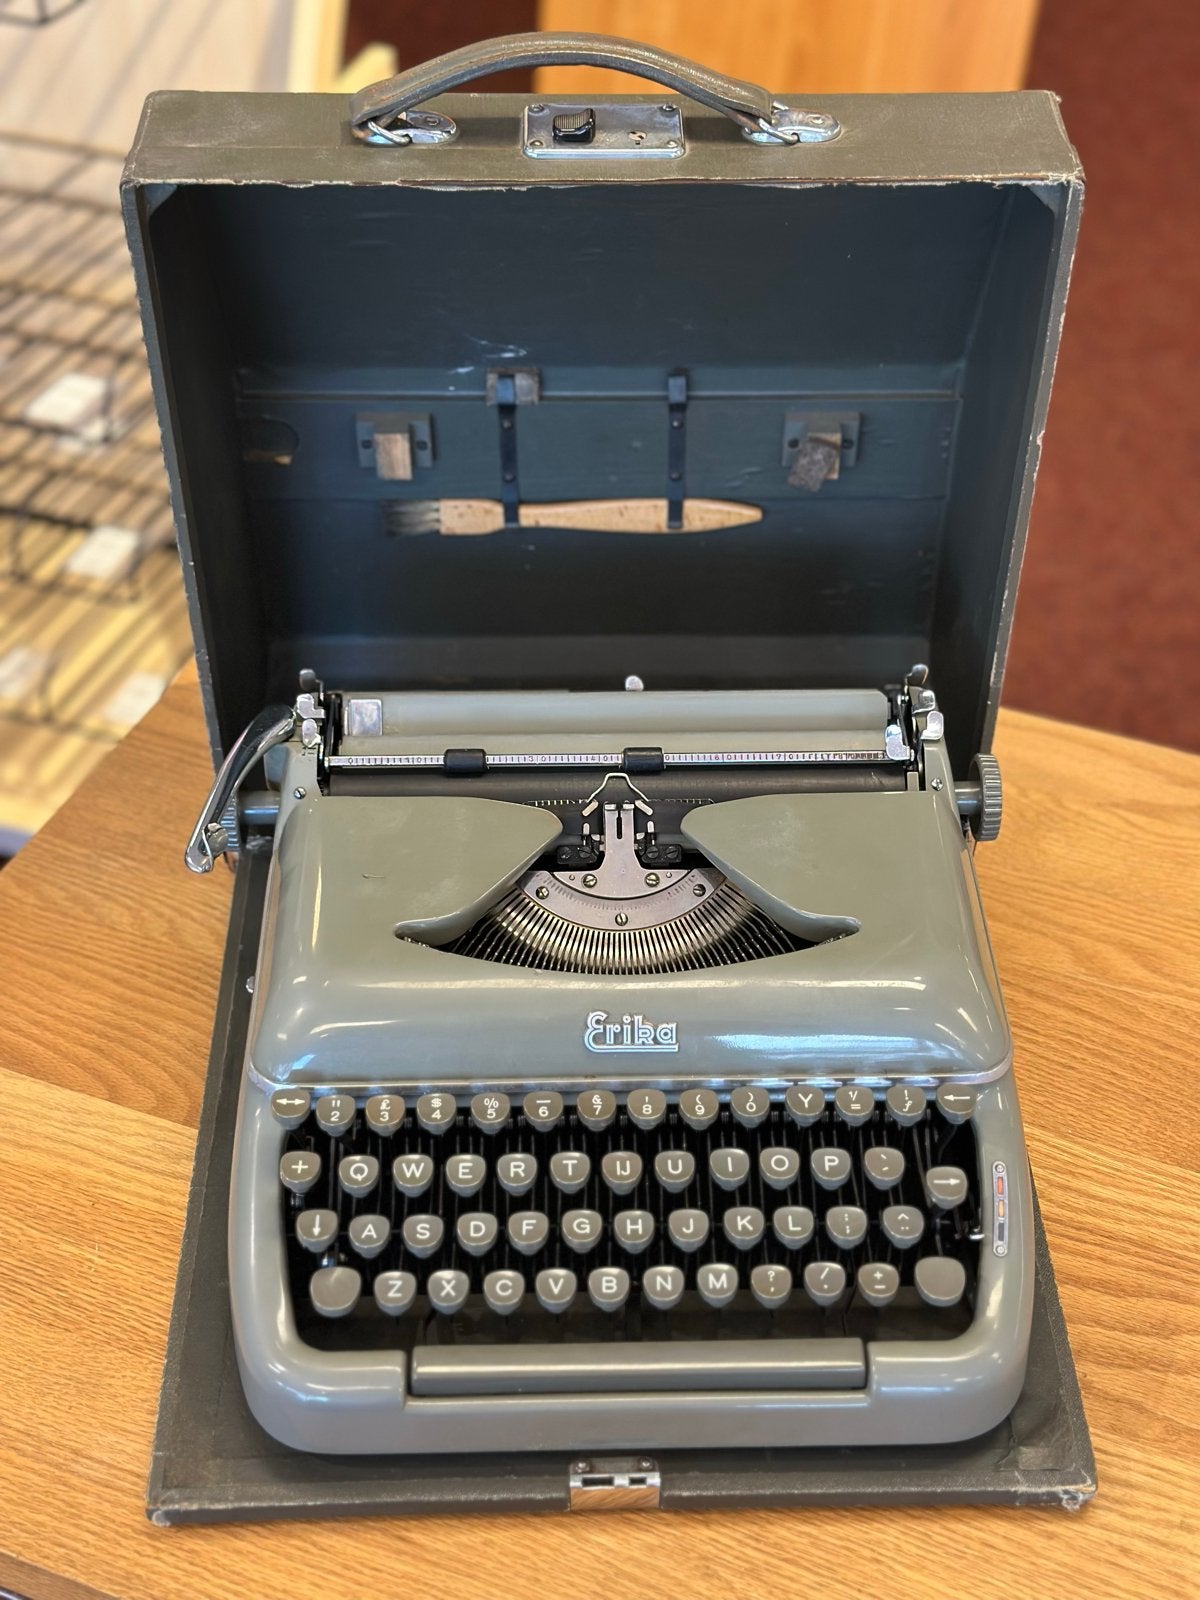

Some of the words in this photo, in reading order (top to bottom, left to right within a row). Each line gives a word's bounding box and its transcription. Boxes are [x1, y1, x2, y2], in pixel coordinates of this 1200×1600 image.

[584, 1010, 679, 1053] Erika
[330, 1110, 340, 1122] 2
[379, 1110, 389, 1122] 3
[431, 1109, 442, 1120] 4
[487, 1109, 496, 1119] 5
[538, 1105, 549, 1118] 6
[593, 1104, 602, 1115] 7
[642, 1103, 652, 1115] 8
[694, 1104, 705, 1115] 9
[798, 1093, 813, 1108] Y
[380, 1098, 391, 1110] £
[431, 1097, 442, 1108] $
[483, 1097, 500, 1109] %
[591, 1094, 603, 1105] &
[904, 1089, 909, 1101] !
[350, 1162, 369, 1183] Q
[401, 1162, 425, 1178] W
[458, 1162, 473, 1179] E
[510, 1161, 526, 1178] R
[562, 1159, 578, 1176] T
[667, 1159, 683, 1175] U
[727, 1156, 733, 1172] I
[770, 1154, 790, 1172] O
[824, 1155, 840, 1172] P
[361, 1223, 377, 1239] A
[416, 1223, 431, 1240] S
[469, 1220, 486, 1237] D
[522, 1219, 537, 1236] F
[572, 1217, 591, 1234] G
[626, 1218, 643, 1235] H
[682, 1217, 694, 1234] J
[736, 1215, 753, 1231] K
[787, 1215, 802, 1231] L
[387, 1279, 403, 1298] Z
[441, 1280, 455, 1296] X
[495, 1279, 513, 1296] C
[548, 1277, 564, 1295] V
[601, 1276, 618, 1294] B
[656, 1275, 672, 1291] N
[708, 1272, 728, 1289] M
[768, 1270, 776, 1281] ?
